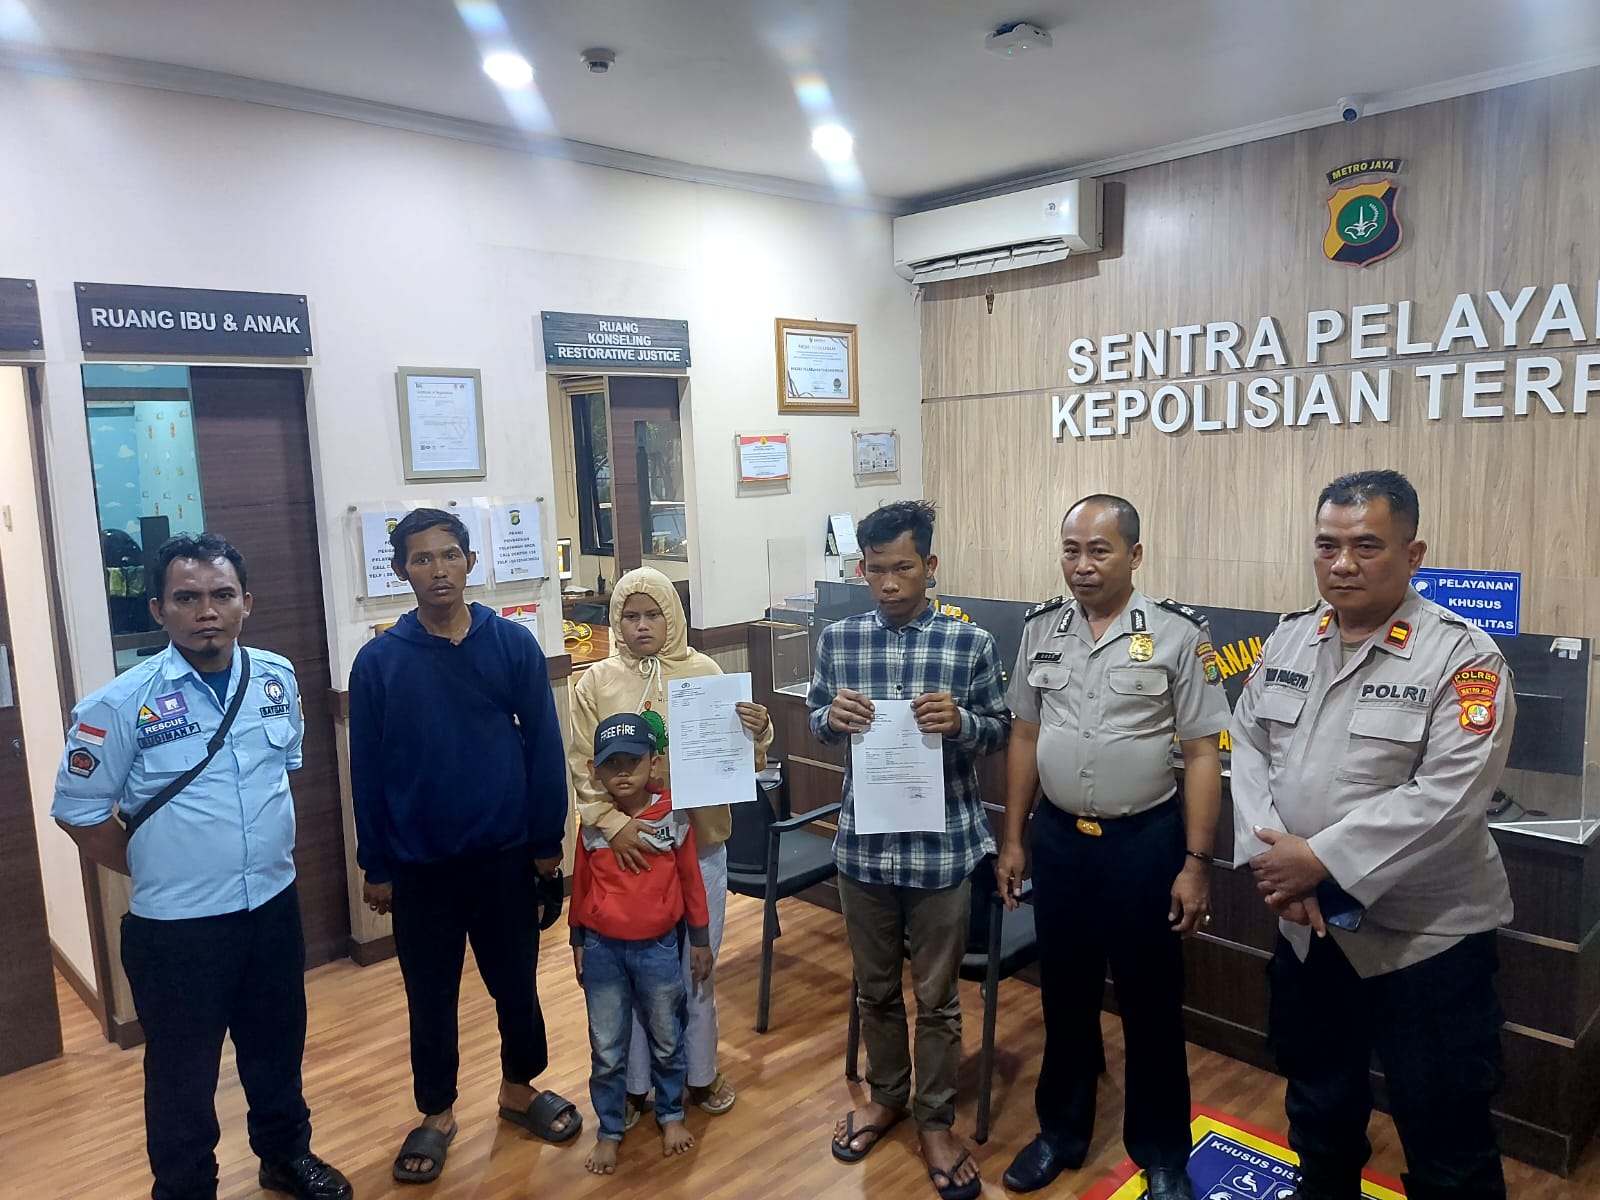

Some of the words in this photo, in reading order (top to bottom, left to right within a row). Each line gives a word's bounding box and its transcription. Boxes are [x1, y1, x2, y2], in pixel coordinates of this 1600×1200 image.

[1332, 163, 1368, 178] METRO
[1370, 160, 1394, 170] JAYA
[91, 307, 174, 329] RUANG
[180, 311, 216, 331] IBU
[223, 313, 238, 332] &
[243, 315, 300, 334] ANAK
[599, 320, 639, 333] RUANG
[587, 333, 652, 346] KONSELING
[1067, 315, 1288, 384] SENTRA
[1306, 280, 1600, 364] PELAYA
[558, 346, 636, 360] RESTORATIVE
[637, 350, 681, 361] JUSTICE
[1051, 367, 1392, 439] KEPOLISIAN
[1439, 578, 1514, 591] PELAYANAN
[1448, 597, 1502, 610] KHUSUS
[1361, 684, 1427, 703] POLRI
[144, 717, 186, 734] RESCUE
[1210, 1140, 1270, 1169] KHUSUS
